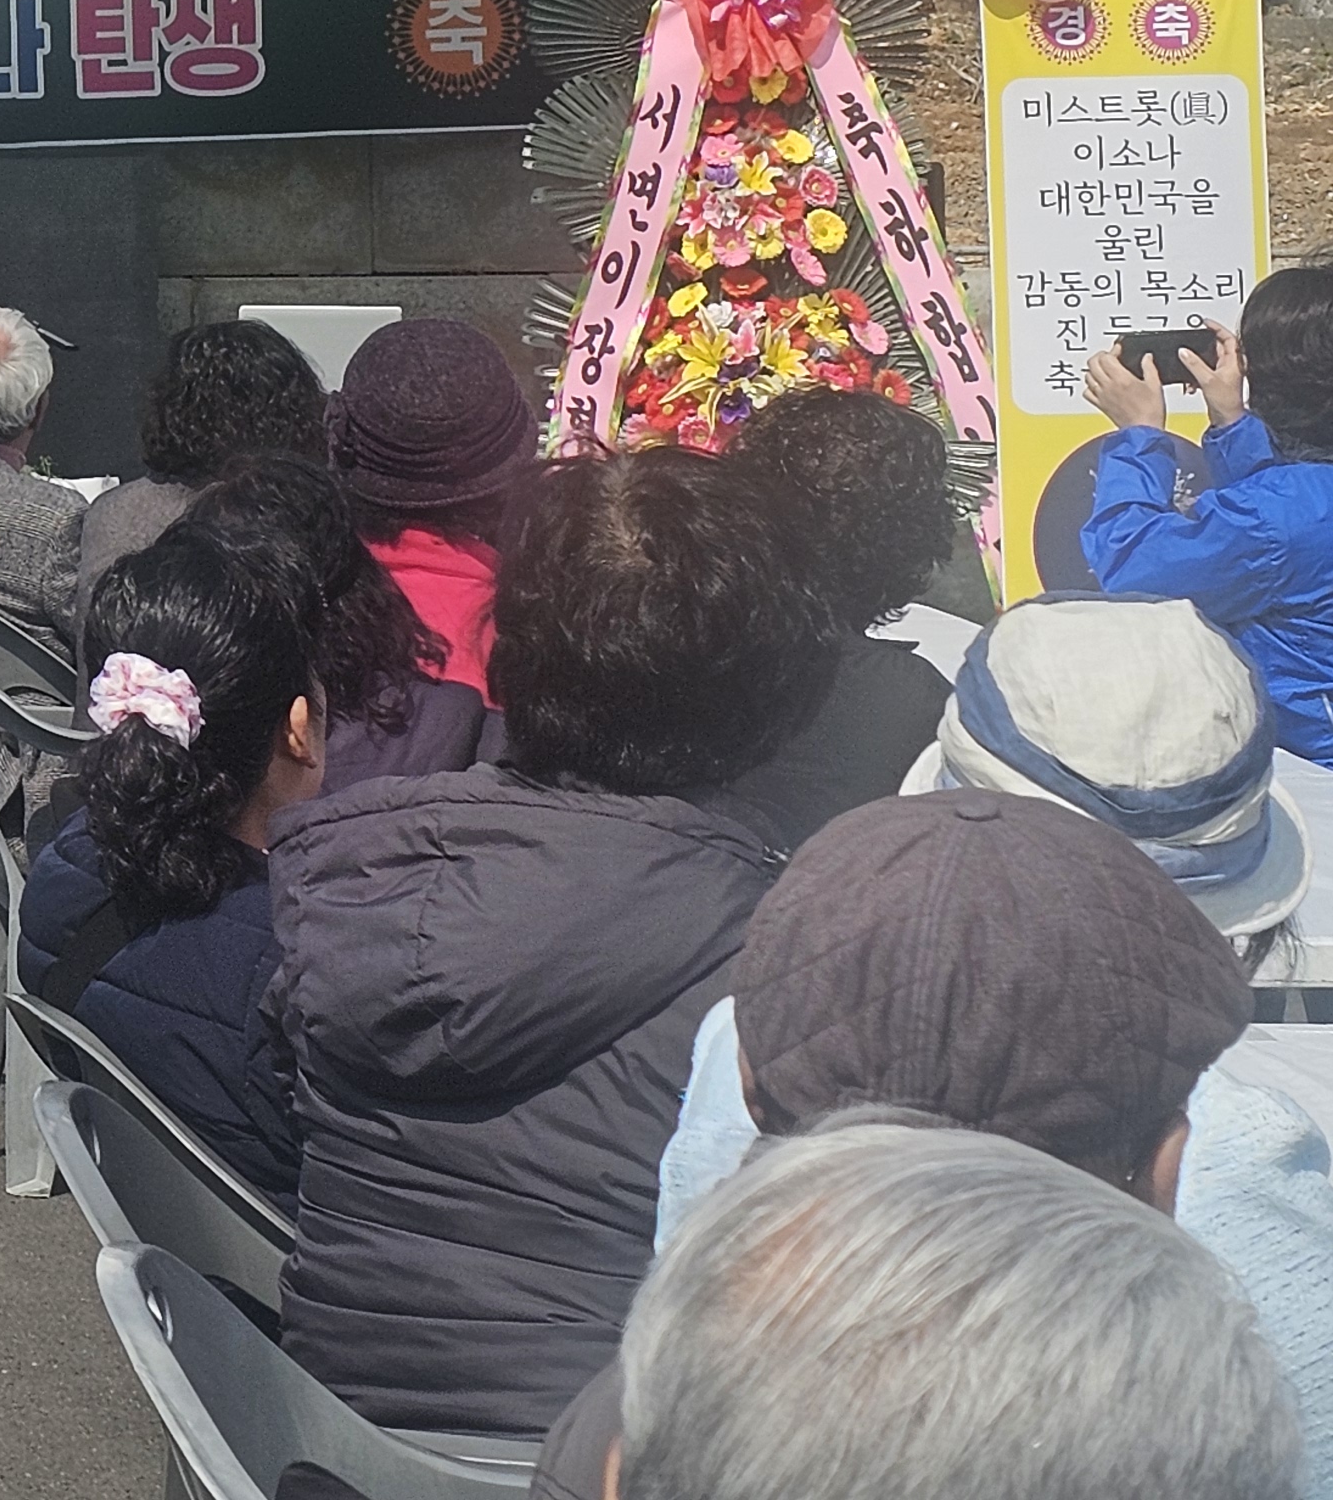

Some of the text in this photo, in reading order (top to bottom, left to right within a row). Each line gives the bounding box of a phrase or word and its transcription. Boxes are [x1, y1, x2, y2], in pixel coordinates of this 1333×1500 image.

[1047, 3, 1191, 46] 경 축
[1023, 90, 1228, 128] 미스트롯(眞)
[1074, 134, 1182, 171] 이소나
[1039, 178, 1220, 217] 대한민국을
[1095, 224, 1165, 261] 울린
[1017, 268, 1244, 308] 감동의 목소리
[1056, 315, 1088, 351] 진
